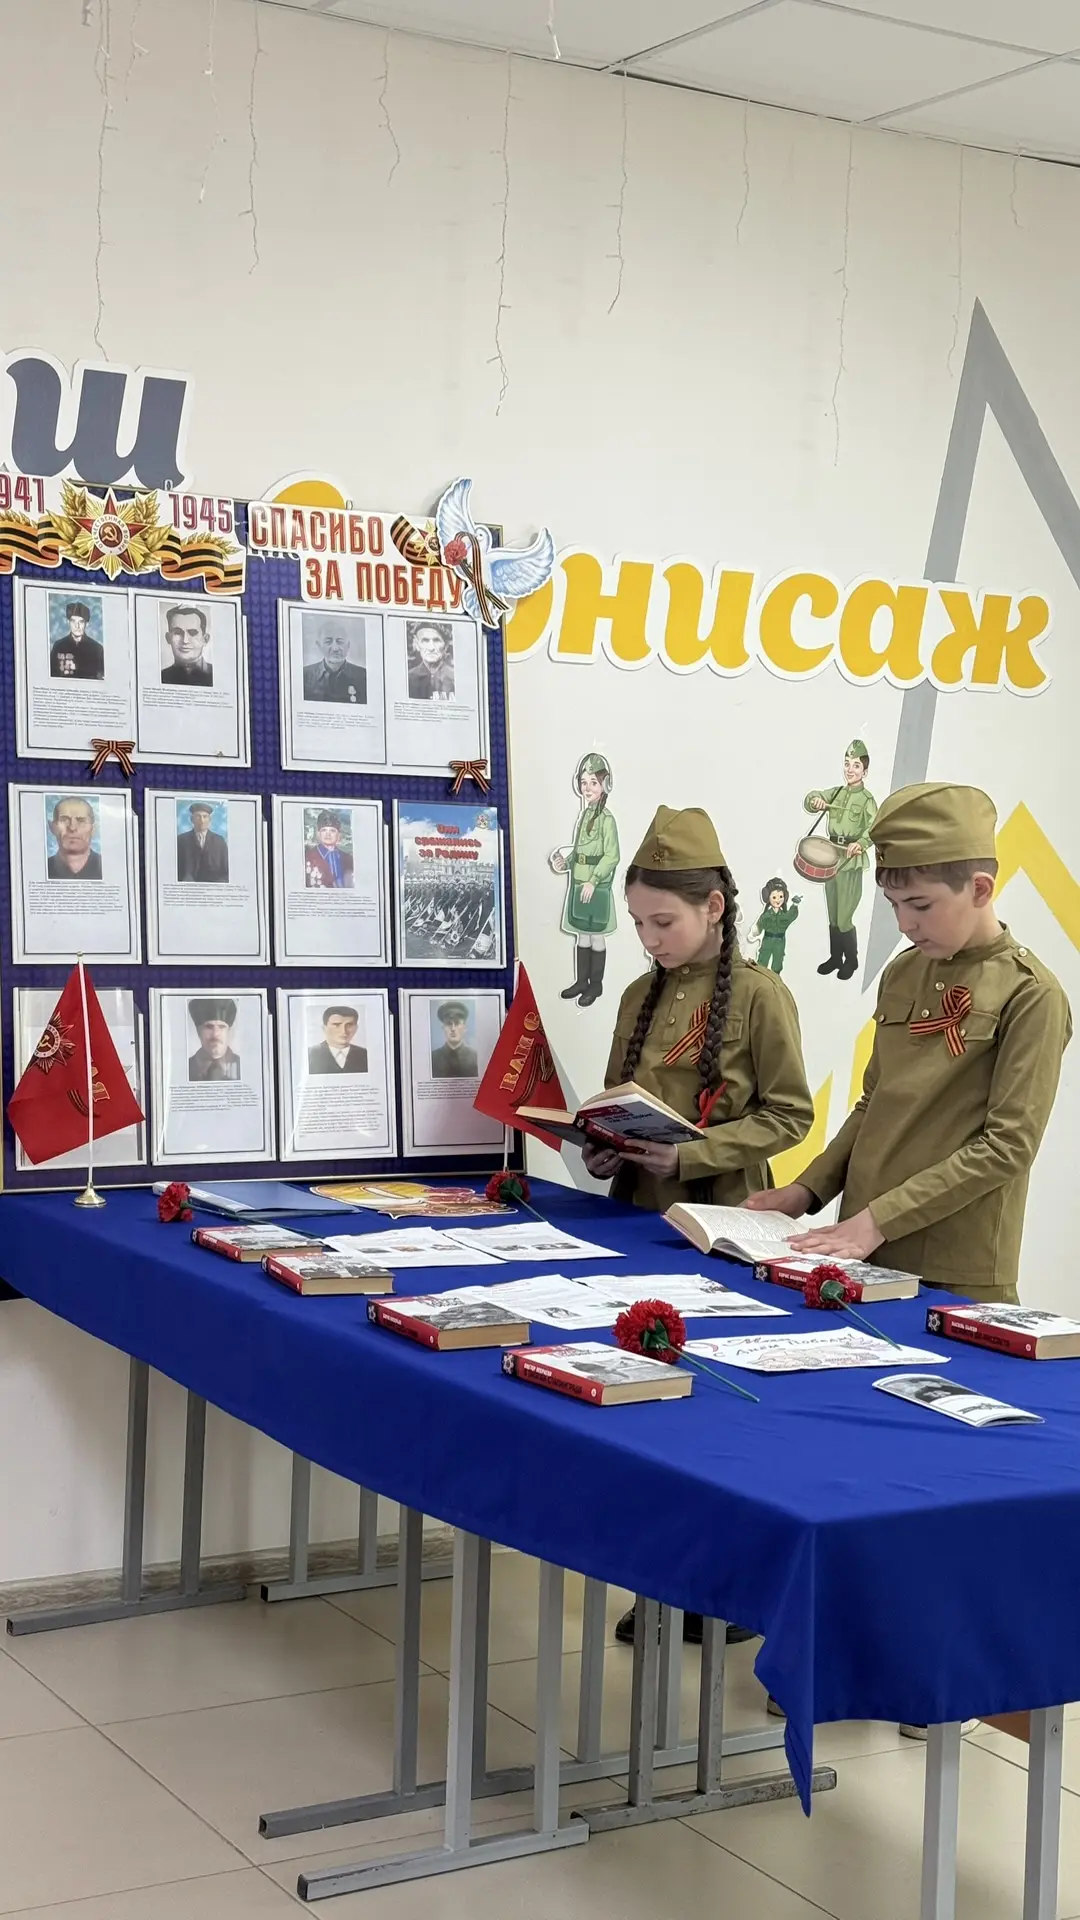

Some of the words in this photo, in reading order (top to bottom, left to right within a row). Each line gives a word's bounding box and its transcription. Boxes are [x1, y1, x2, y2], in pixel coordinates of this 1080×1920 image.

[0, 357, 187, 490] ш
[168, 493, 233, 533] 1945
[251, 504, 385, 556] СПАСИБО
[305, 558, 343, 600] ЗА
[356, 561, 464, 612] ПОБЕДУ
[507, 552, 1050, 689] нисаж
